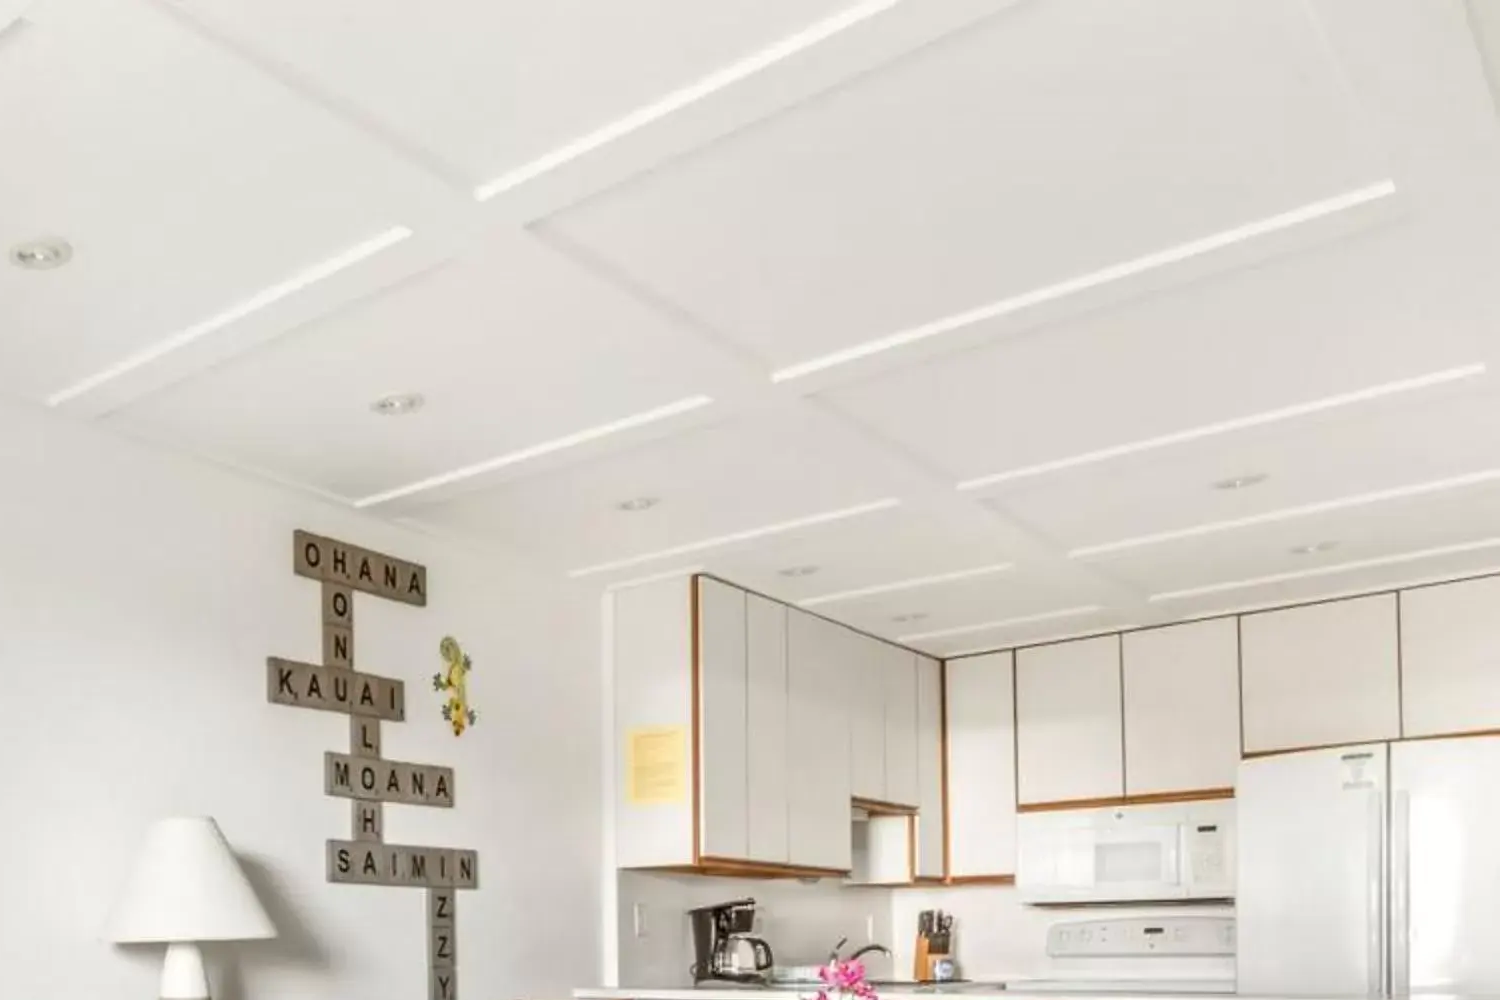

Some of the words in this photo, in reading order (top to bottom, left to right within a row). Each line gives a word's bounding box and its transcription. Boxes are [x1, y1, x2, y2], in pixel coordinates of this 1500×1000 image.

[304, 543, 422, 594] OHANA
[277, 668, 396, 710] KAUAI
[334, 762, 449, 798] MOANA
[337, 849, 472, 880] SAIMIN
